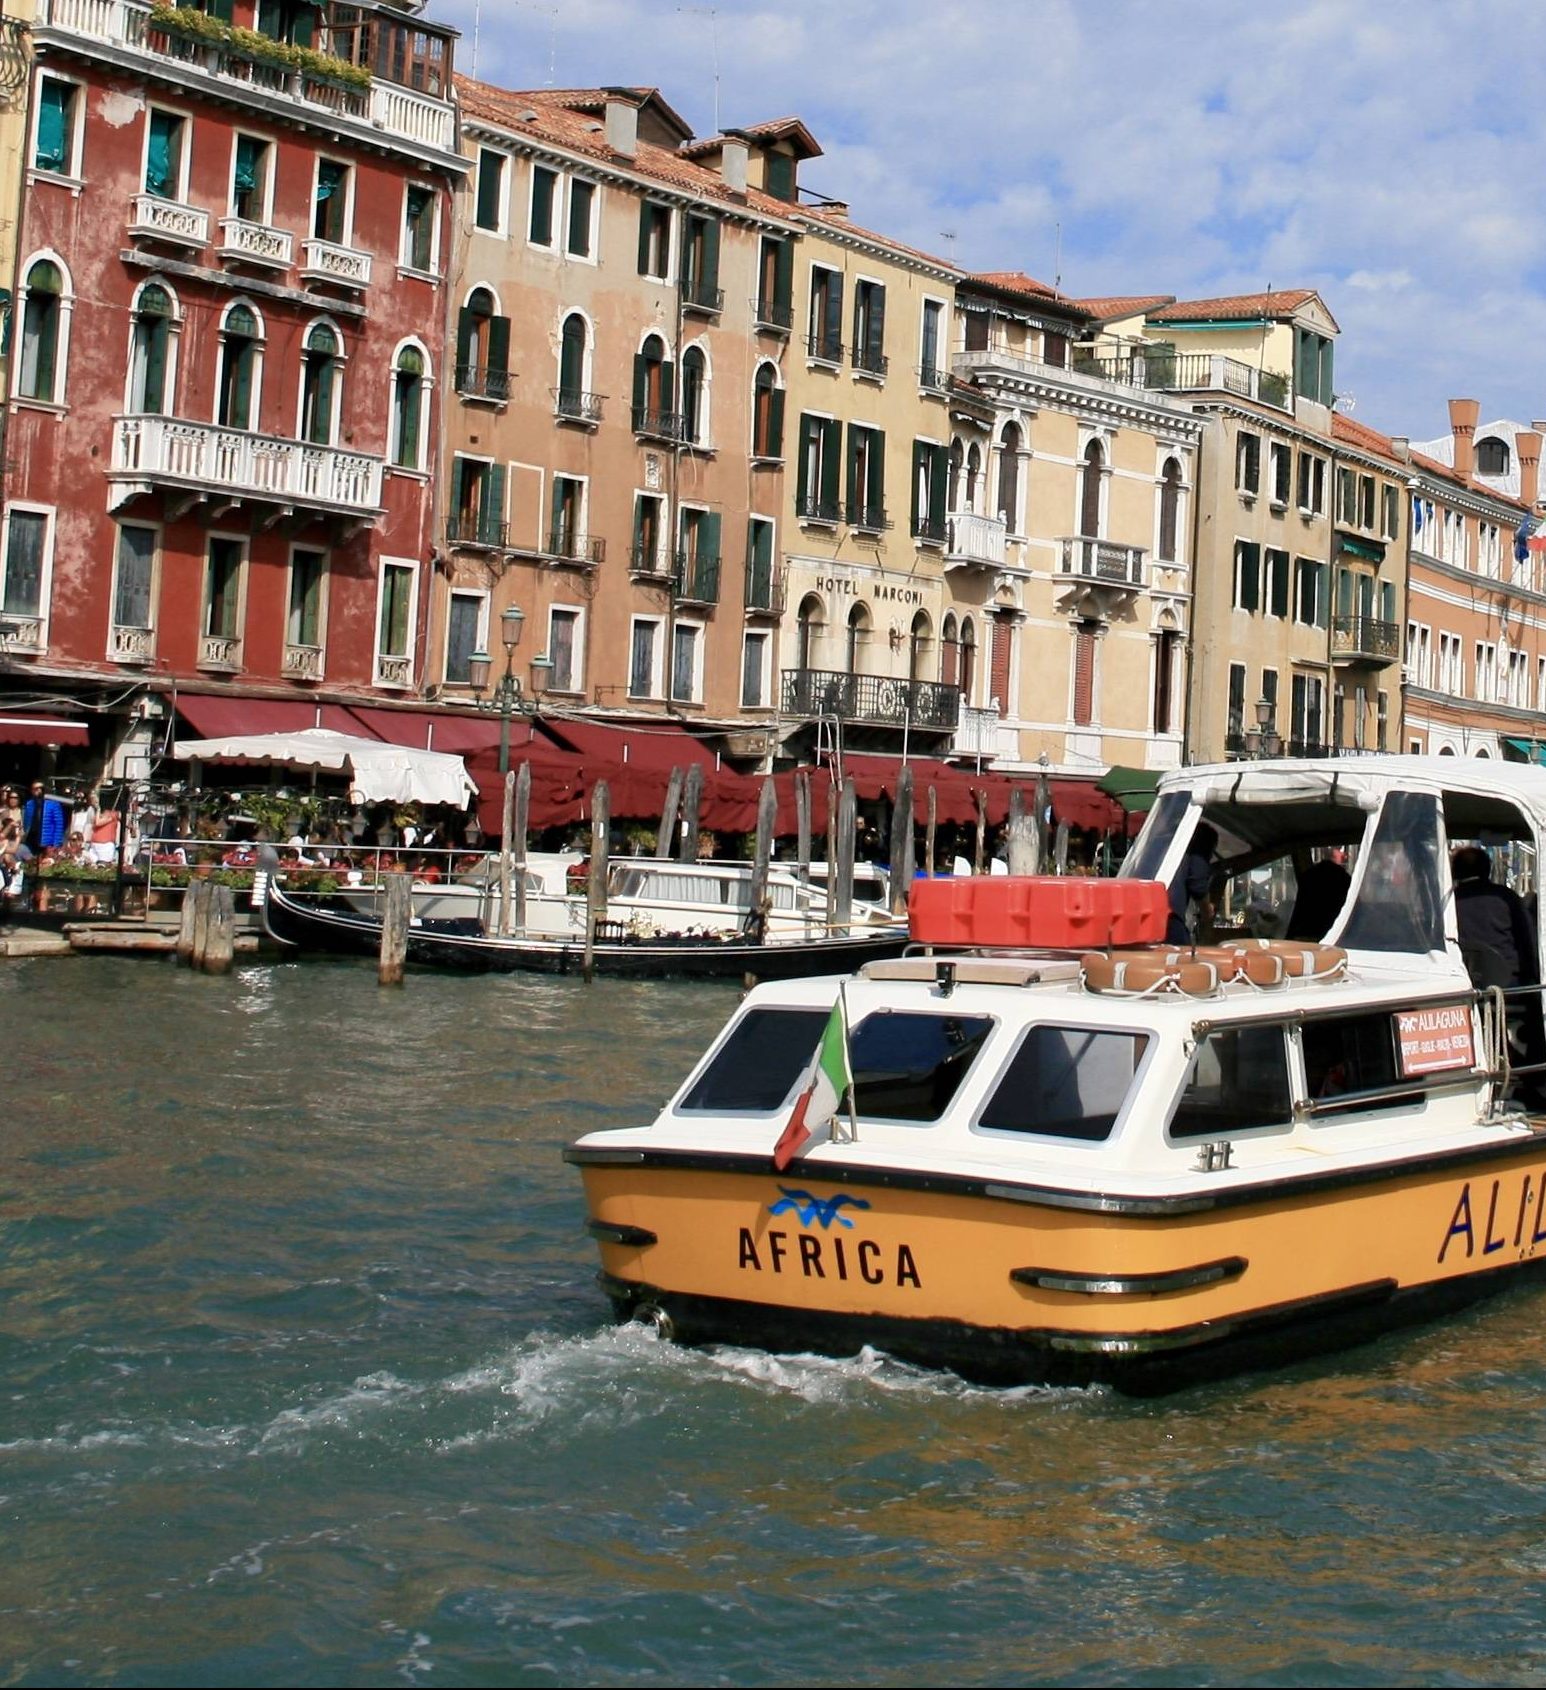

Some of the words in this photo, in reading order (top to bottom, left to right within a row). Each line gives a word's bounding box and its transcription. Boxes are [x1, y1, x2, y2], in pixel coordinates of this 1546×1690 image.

[816, 576, 860, 596] HOTEL
[874, 584, 923, 606] MARCONI
[1418, 1009, 1467, 1032] ALILAGUNA
[738, 1227, 922, 1289] AFRICA
